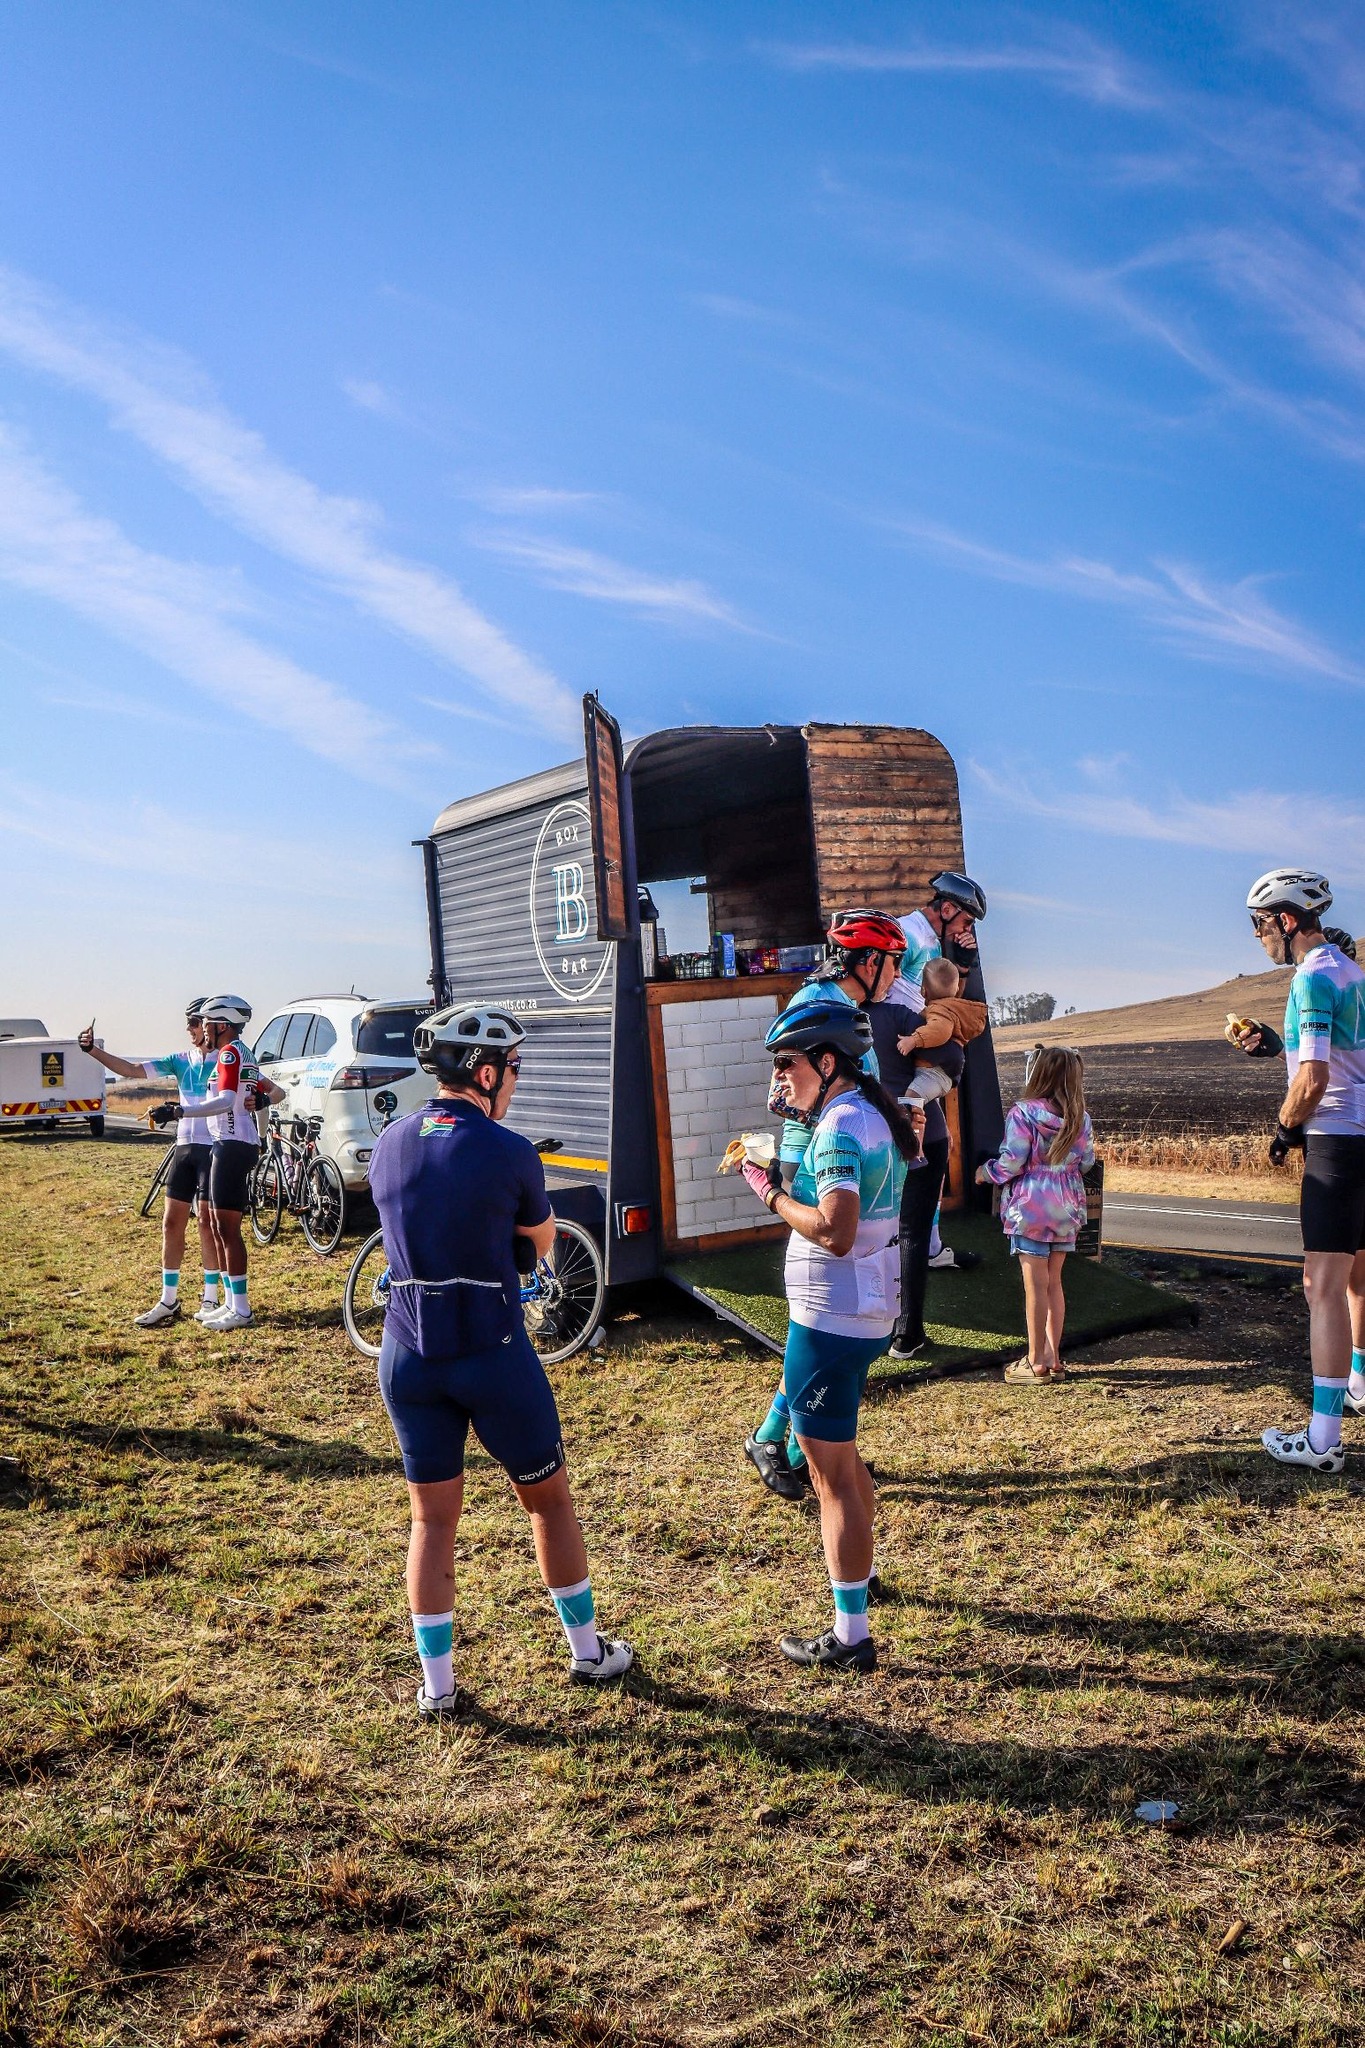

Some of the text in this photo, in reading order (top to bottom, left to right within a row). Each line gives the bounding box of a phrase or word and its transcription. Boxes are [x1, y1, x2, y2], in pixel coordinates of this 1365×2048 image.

[556, 825, 579, 847] BOX
[552, 862, 589, 944] B
[561, 957, 588, 975] BAR
[465, 1047, 482, 1070] POC
[827, 1165, 856, 1176] RESCUE
